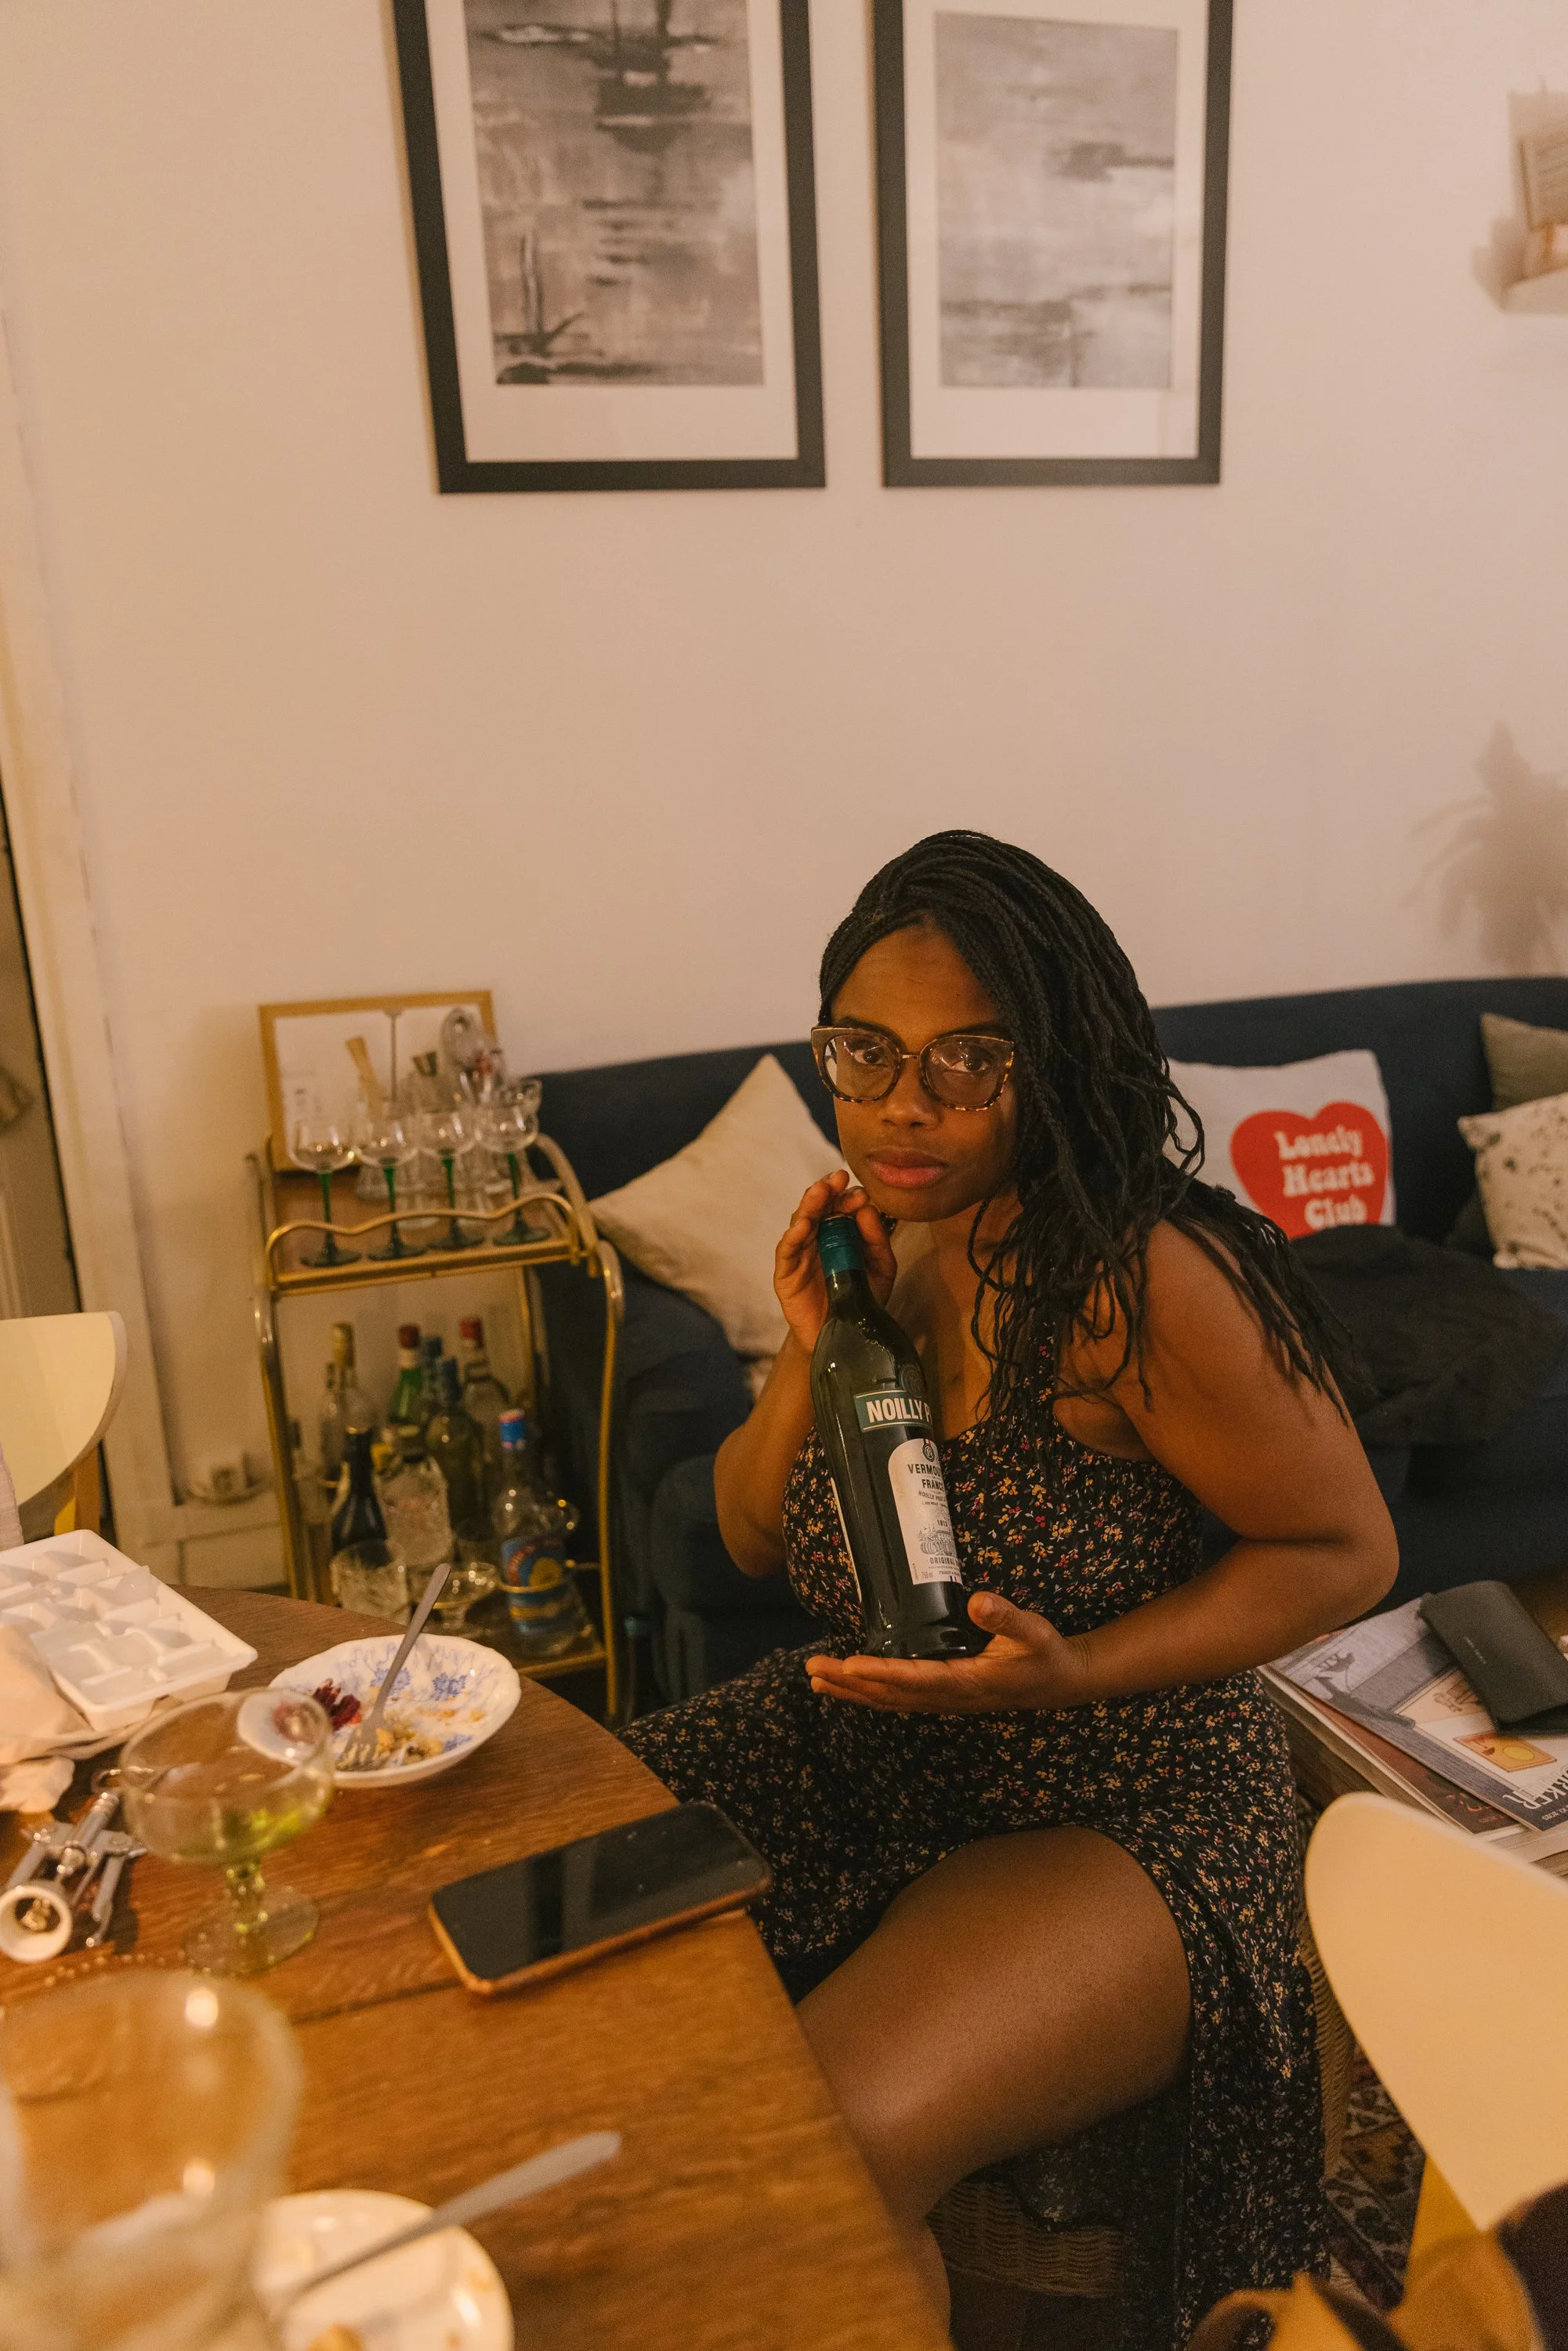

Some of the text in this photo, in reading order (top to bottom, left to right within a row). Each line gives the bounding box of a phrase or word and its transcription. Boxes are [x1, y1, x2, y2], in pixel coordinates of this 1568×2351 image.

[1274, 1125, 1363, 1160] Lonely
[1281, 1160, 1374, 1197] Hearts
[1304, 1194, 1367, 1230] Club
[866, 1398, 922, 1423] NOILLY
[929, 1556, 955, 1565] ORIGINAL
